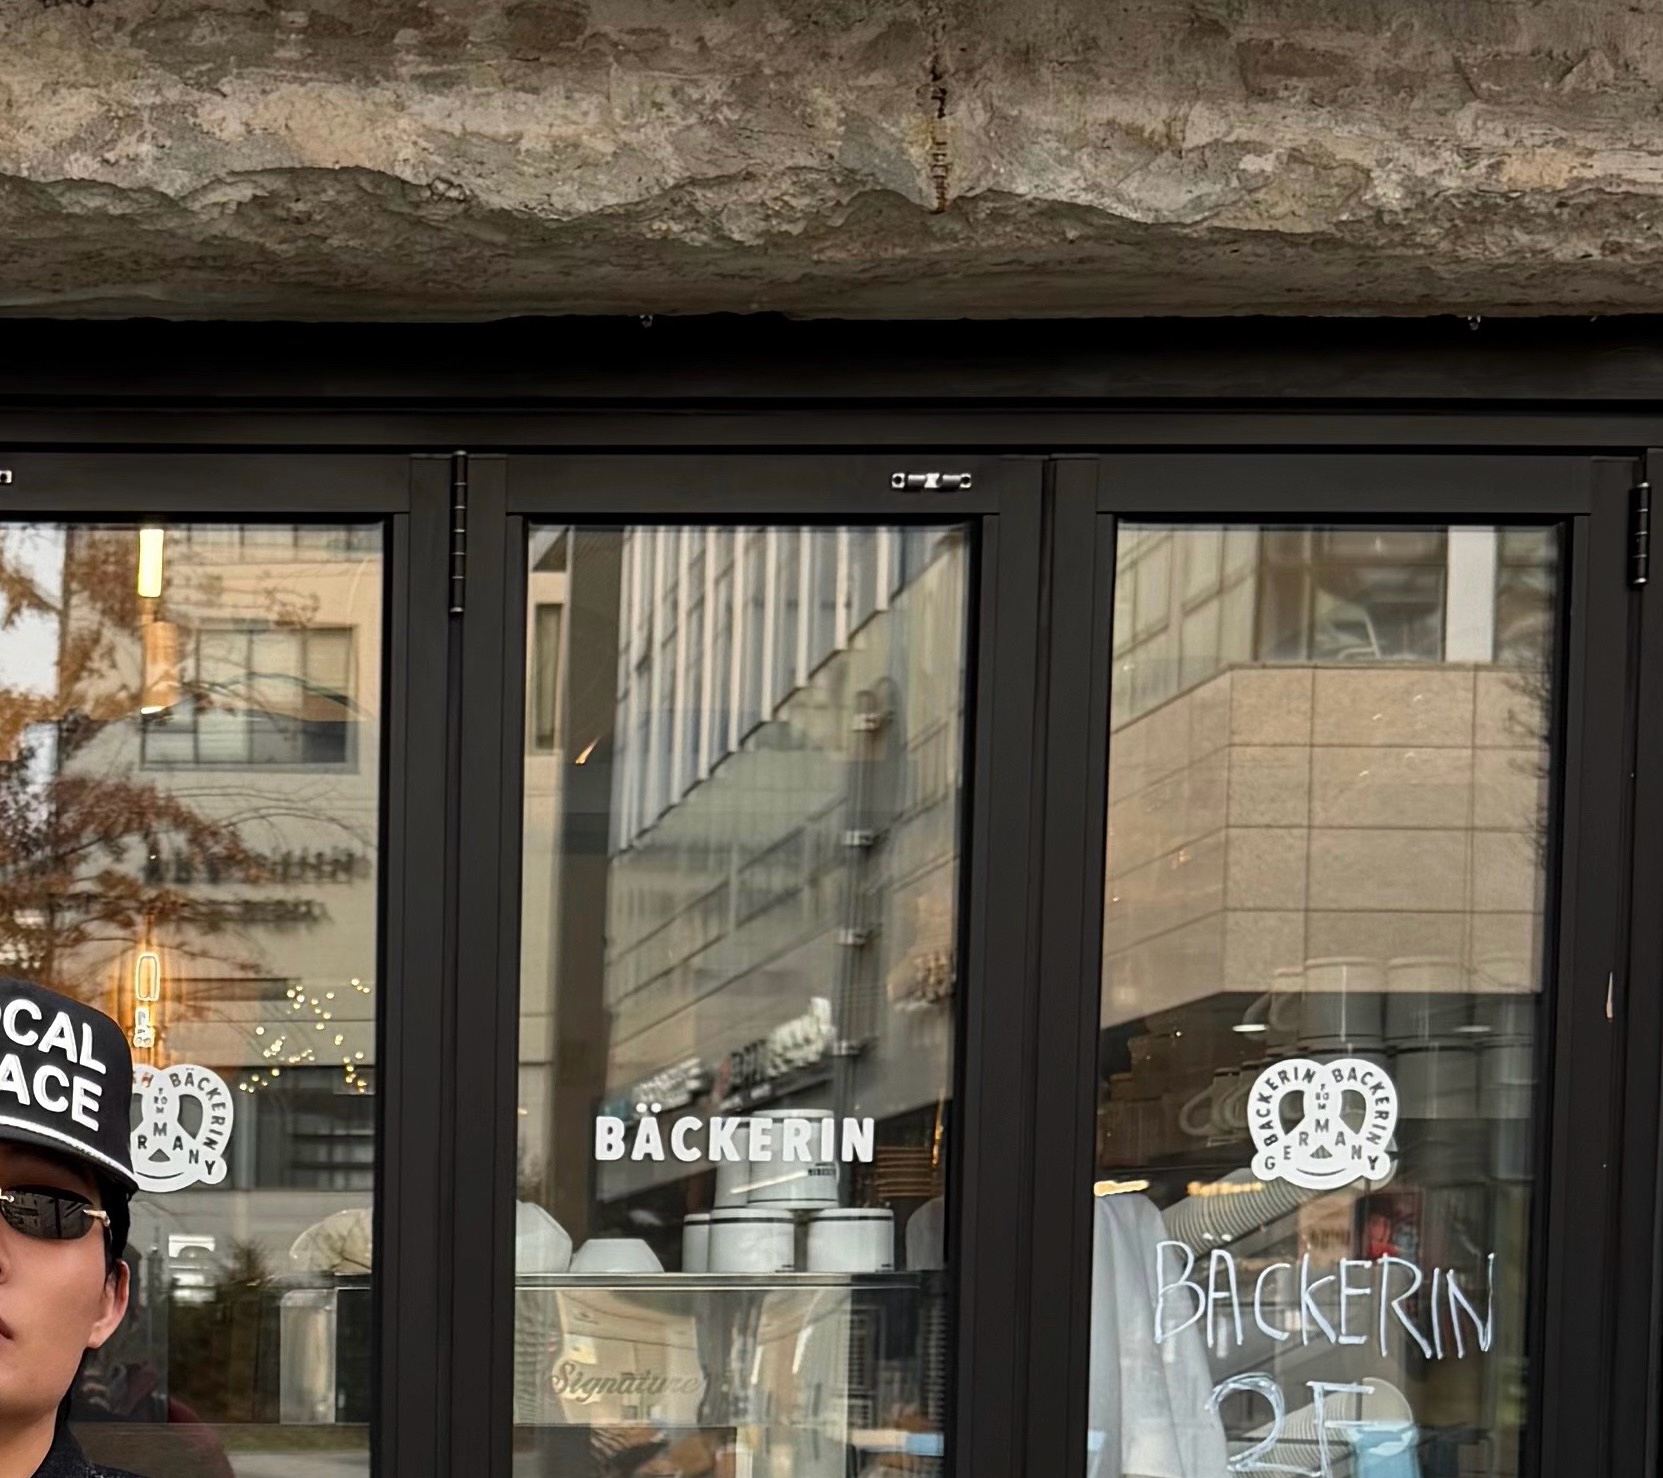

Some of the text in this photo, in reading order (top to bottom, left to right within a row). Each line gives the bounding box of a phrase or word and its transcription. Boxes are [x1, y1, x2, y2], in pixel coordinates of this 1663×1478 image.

[595, 1102, 875, 1163] BÄCKERIN
[1265, 1118, 1379, 1171] GERMANY
[1154, 1232, 1495, 1360] BÄCKERIN
